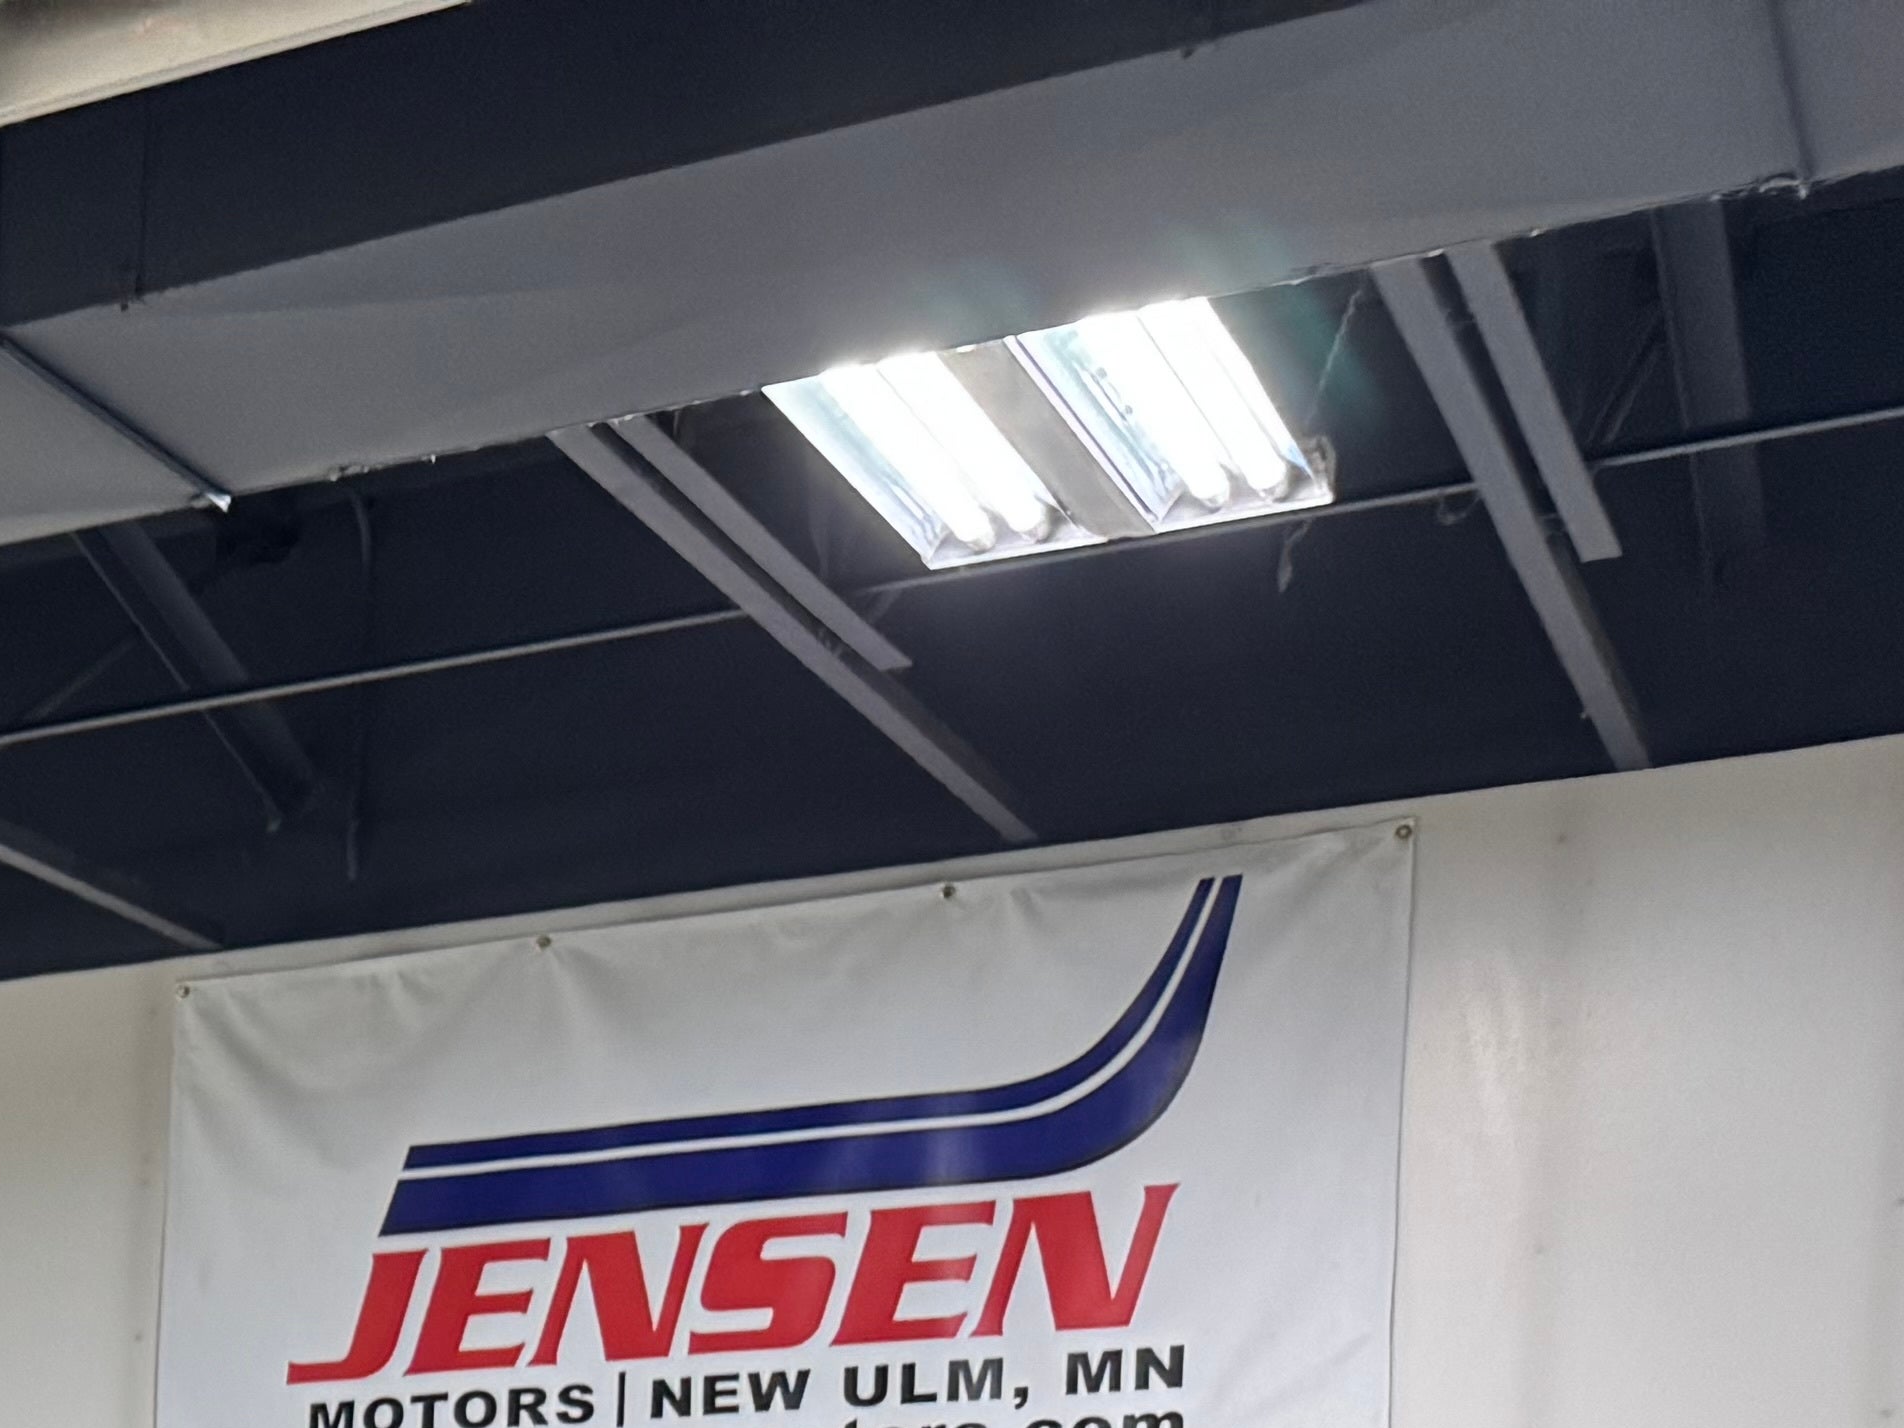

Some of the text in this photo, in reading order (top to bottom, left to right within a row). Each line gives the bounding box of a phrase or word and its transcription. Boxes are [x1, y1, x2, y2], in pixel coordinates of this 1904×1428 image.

[286, 1184, 1180, 1385] JENSEN
[650, 1369, 811, 1419] NEW
[843, 1357, 1030, 1410] ULM,
[1066, 1345, 1185, 1395] MN
